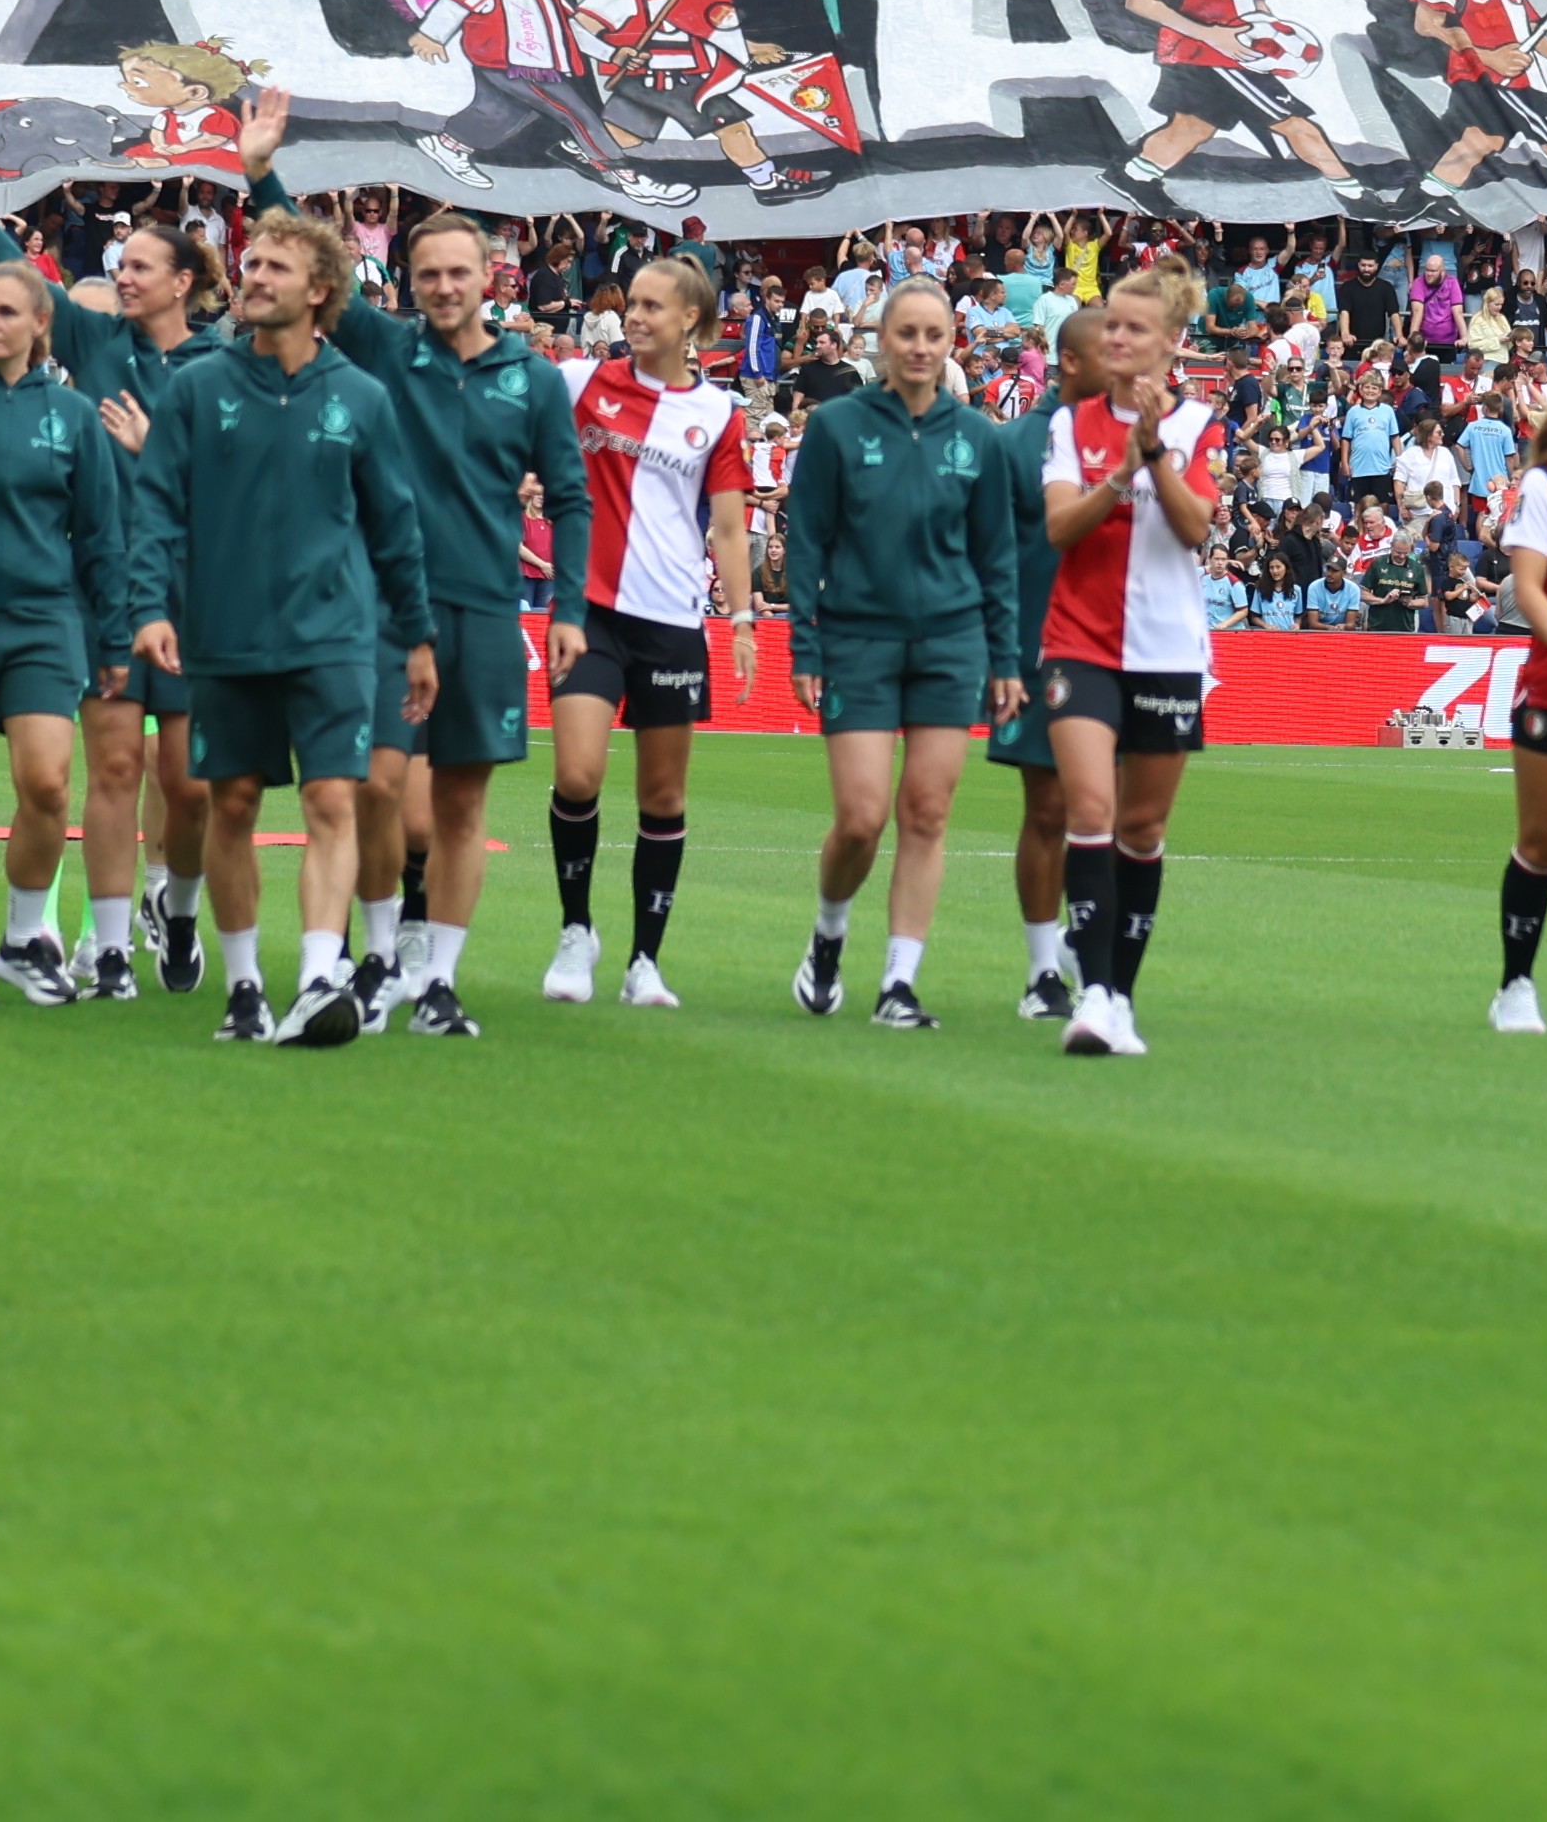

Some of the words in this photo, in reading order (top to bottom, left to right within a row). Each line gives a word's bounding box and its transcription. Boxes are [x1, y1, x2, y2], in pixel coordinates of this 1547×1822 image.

[648, 889, 673, 913] F
[1068, 900, 1097, 931] F
[1124, 911, 1153, 939] F
[1505, 913, 1539, 940] F
